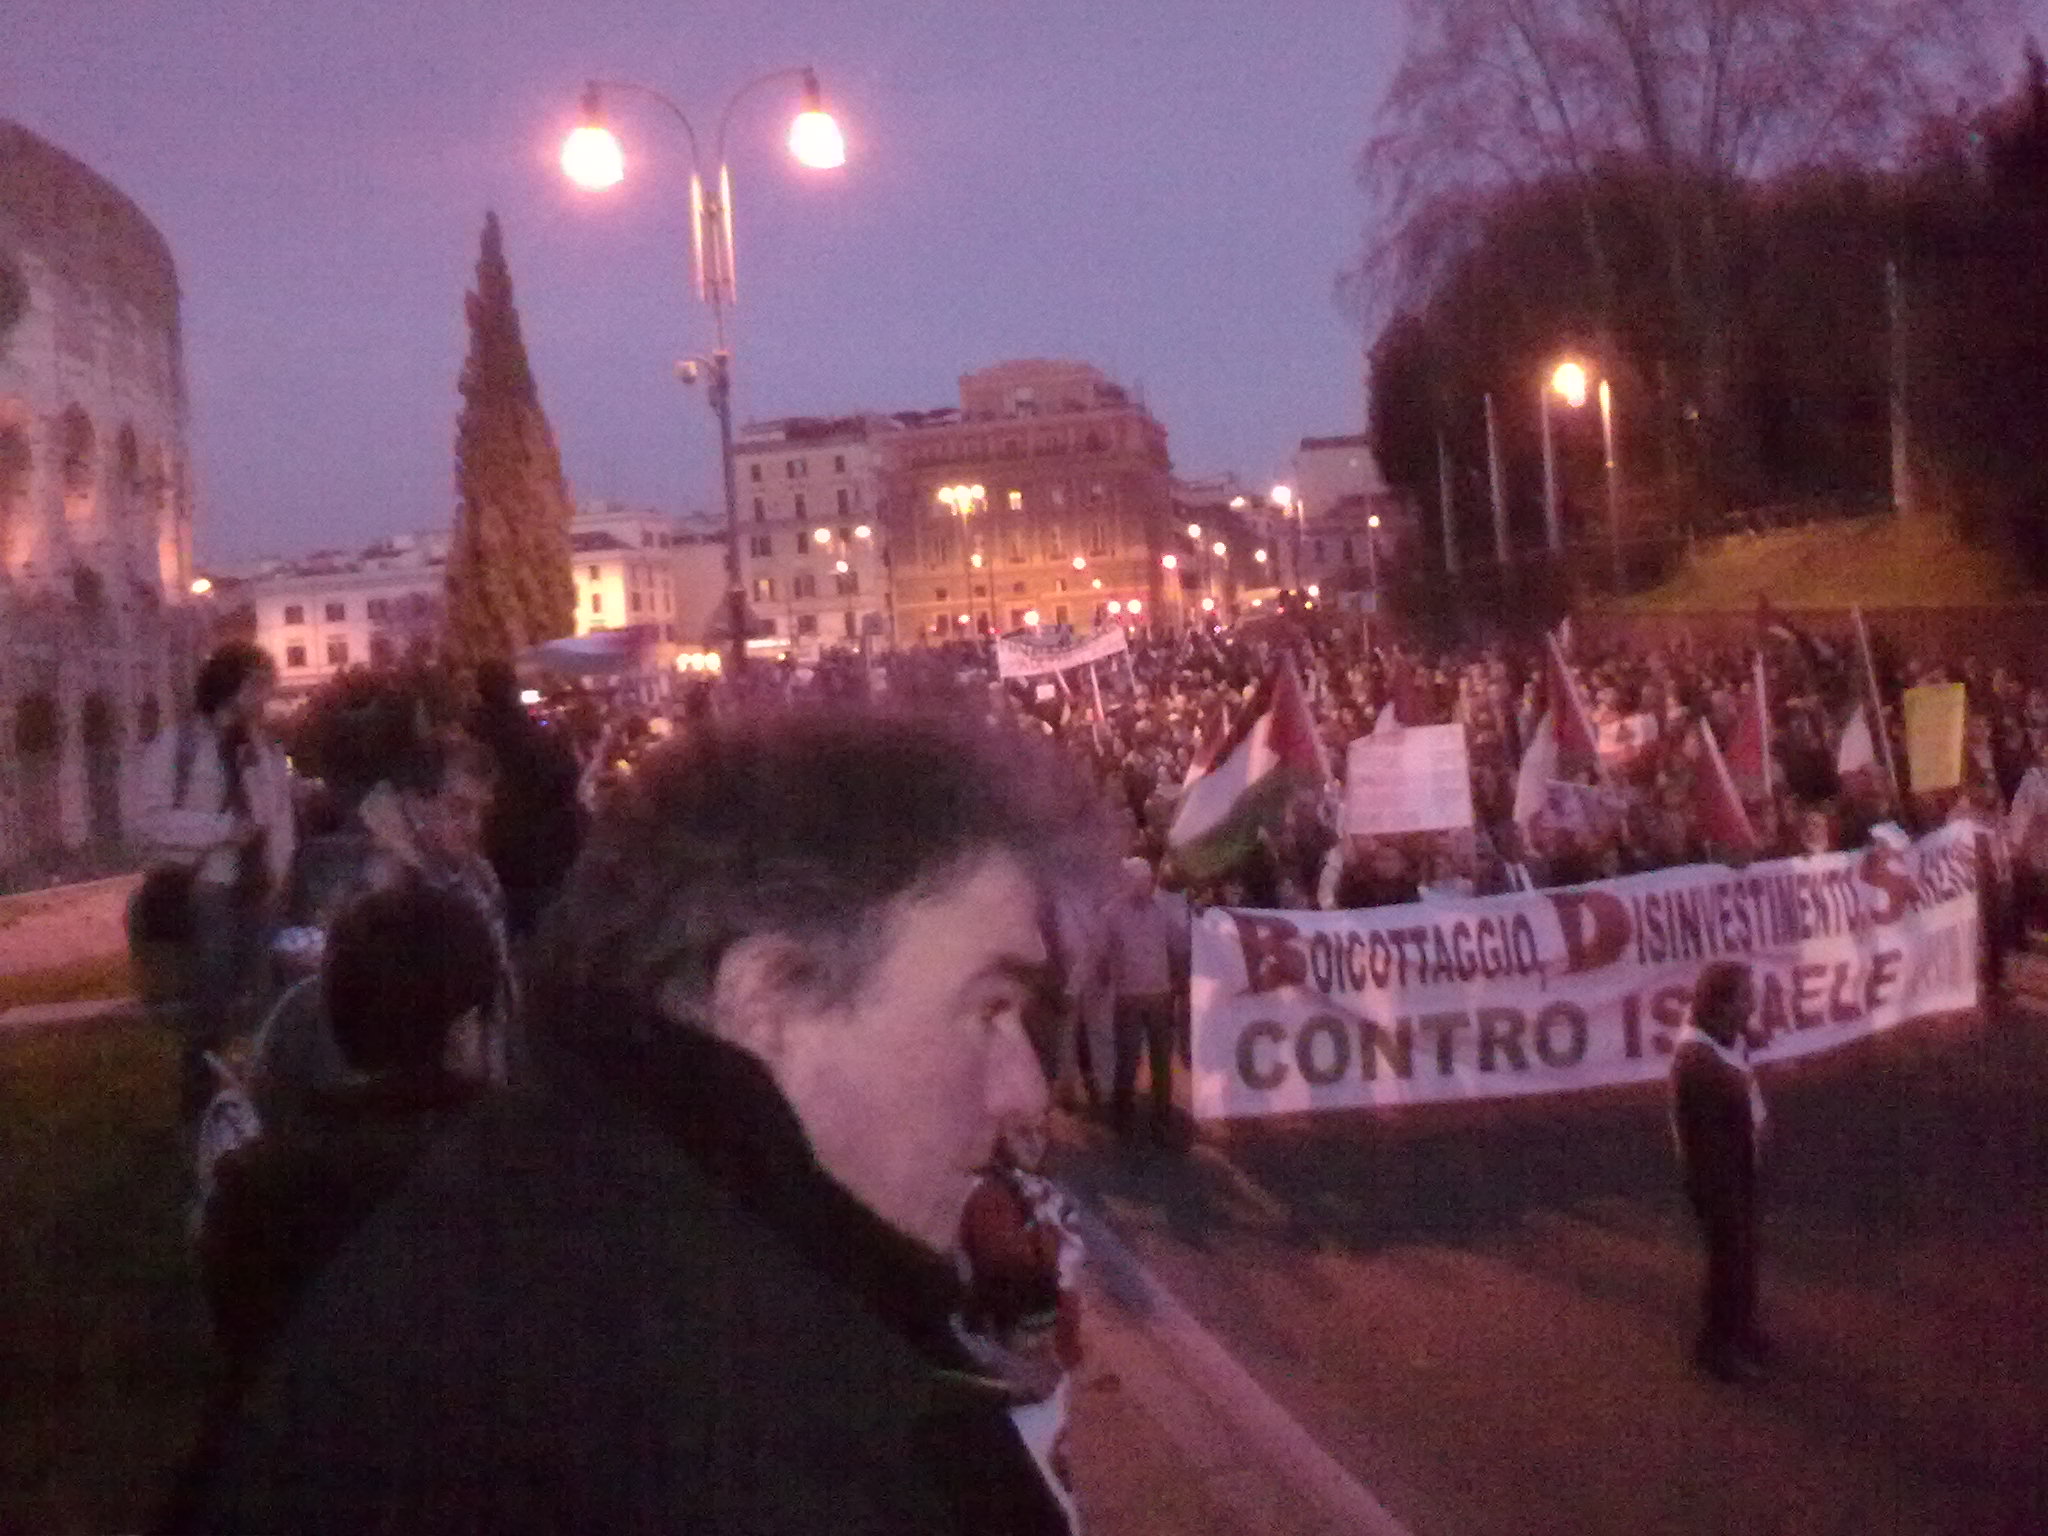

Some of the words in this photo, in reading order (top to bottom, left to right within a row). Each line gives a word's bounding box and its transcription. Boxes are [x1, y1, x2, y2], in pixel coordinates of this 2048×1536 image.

[1235, 912, 1547, 993] BOICOTTAGGIO,
[1235, 1001, 1588, 1090] CONTRO
[1622, 948, 1902, 1058] ISAELE
